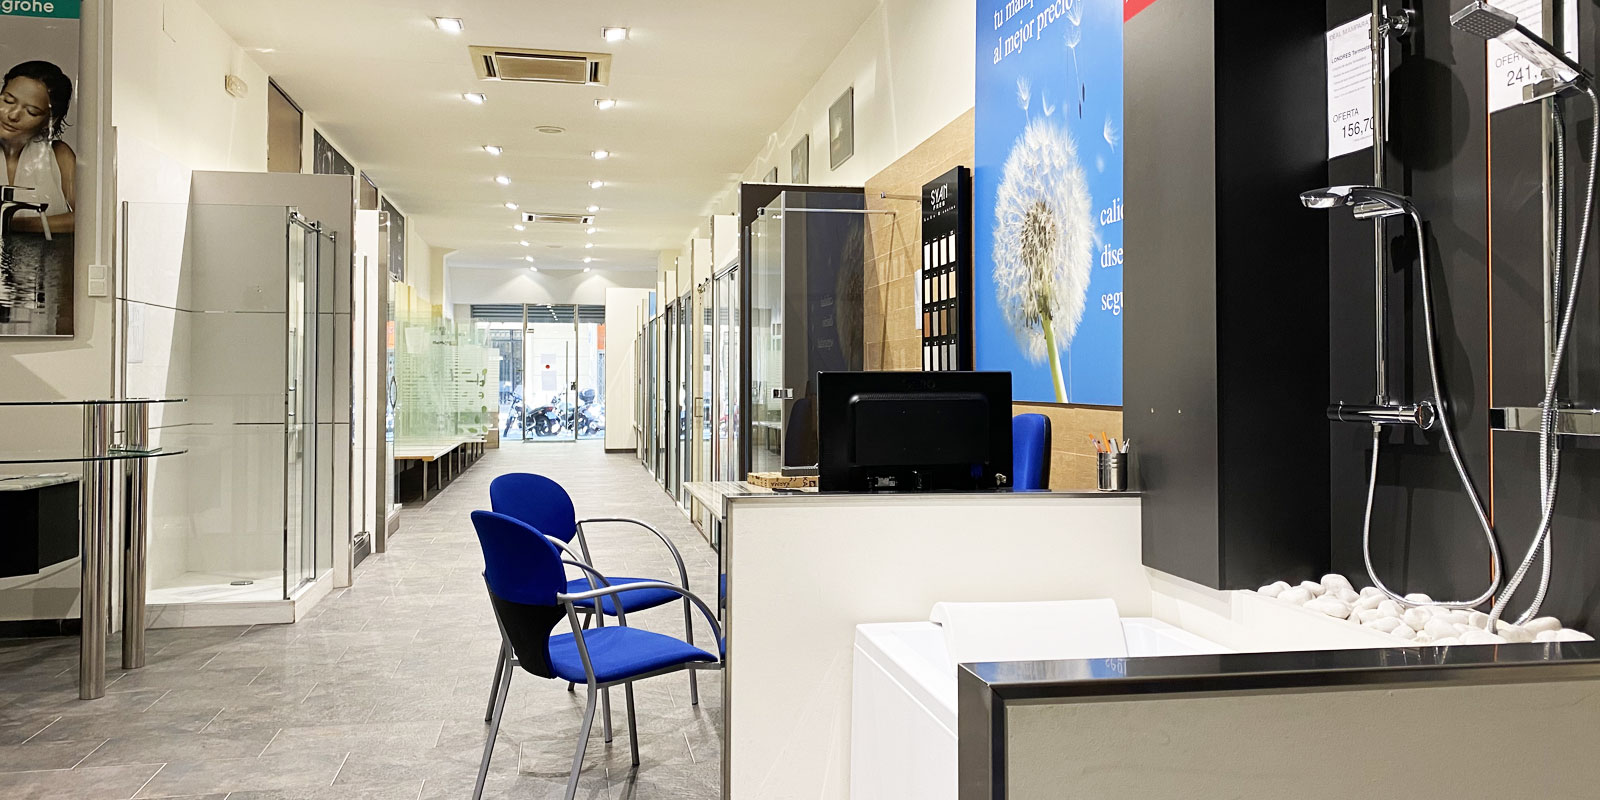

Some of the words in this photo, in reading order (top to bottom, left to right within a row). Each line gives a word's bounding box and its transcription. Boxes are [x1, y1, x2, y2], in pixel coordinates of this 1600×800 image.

[0, 0, 54, 13] grohe
[994, 10, 1003, 30] tu
[993, 37, 1002, 64] al
[1004, 19, 1035, 57] mejor
[1037, 0, 1073, 40] precio
[1495, 52, 1524, 68] OFER
[1332, 107, 1359, 123] OFERTA
[1100, 243, 1123, 268] dise
